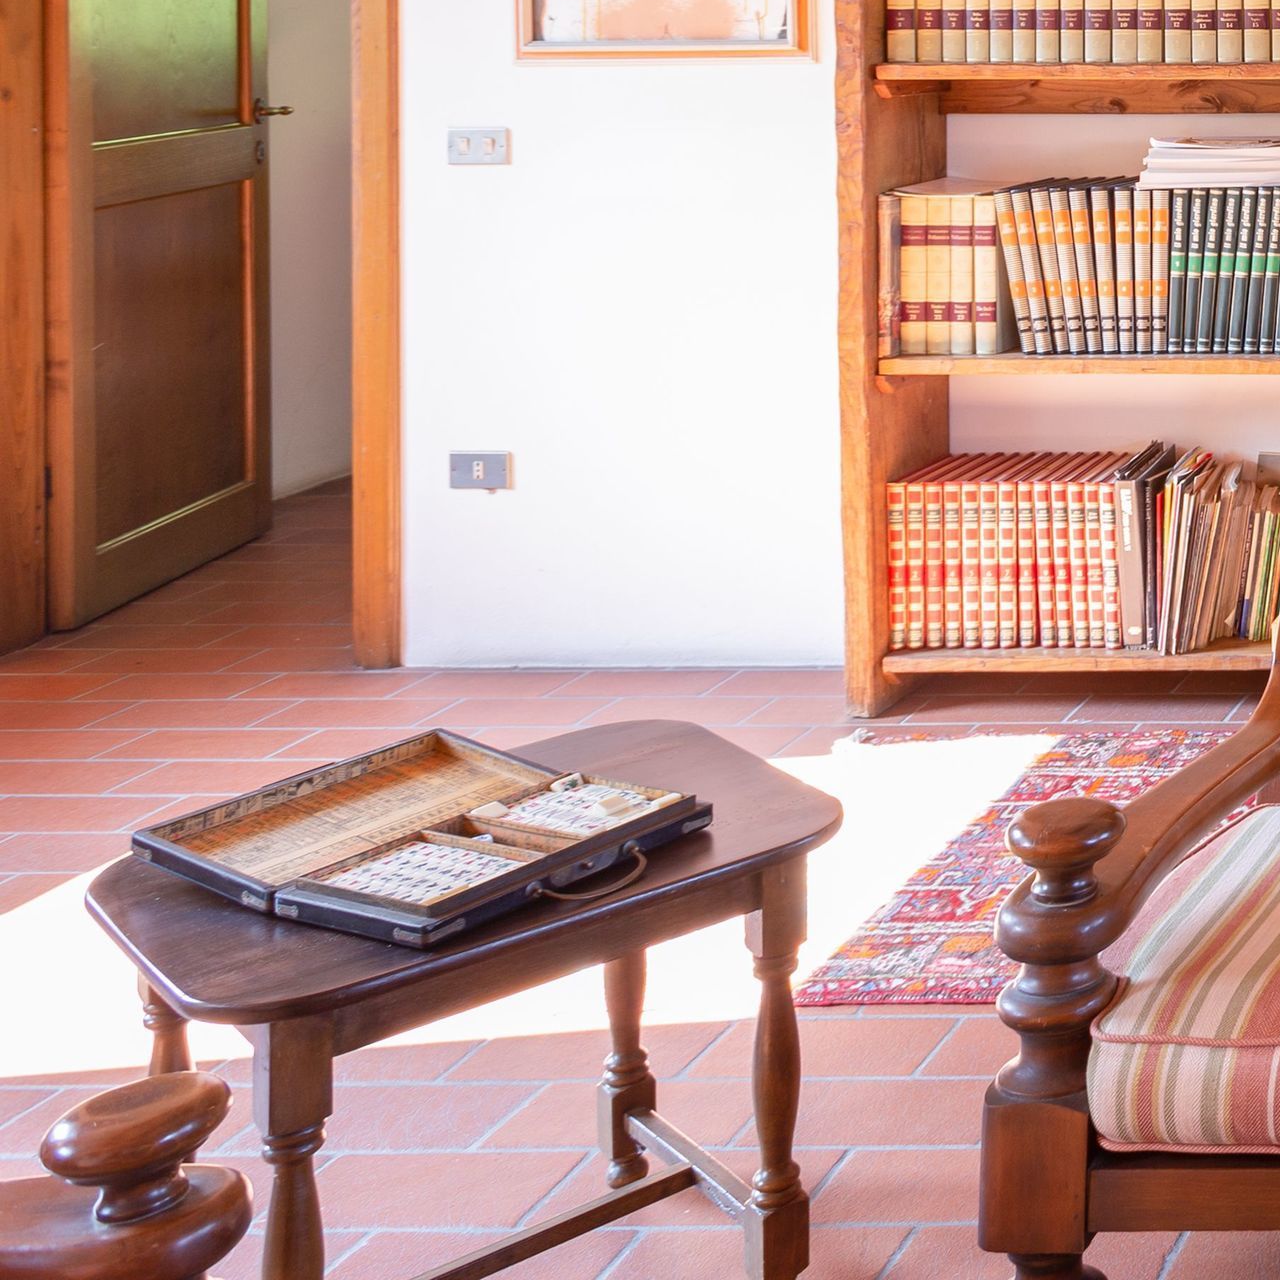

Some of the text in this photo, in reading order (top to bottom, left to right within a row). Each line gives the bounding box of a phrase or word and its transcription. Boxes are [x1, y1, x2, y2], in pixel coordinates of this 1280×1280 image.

[1174, 197, 1184, 227] giardino
[1192, 199, 1202, 243] mio giardino
[1208, 199, 1219, 243] mio giardino
[1224, 199, 1235, 243] mio giardino
[1240, 199, 1251, 243] mio giardino
[1256, 199, 1266, 243] mio giardino
[1271, 199, 1280, 243] mio giardino
